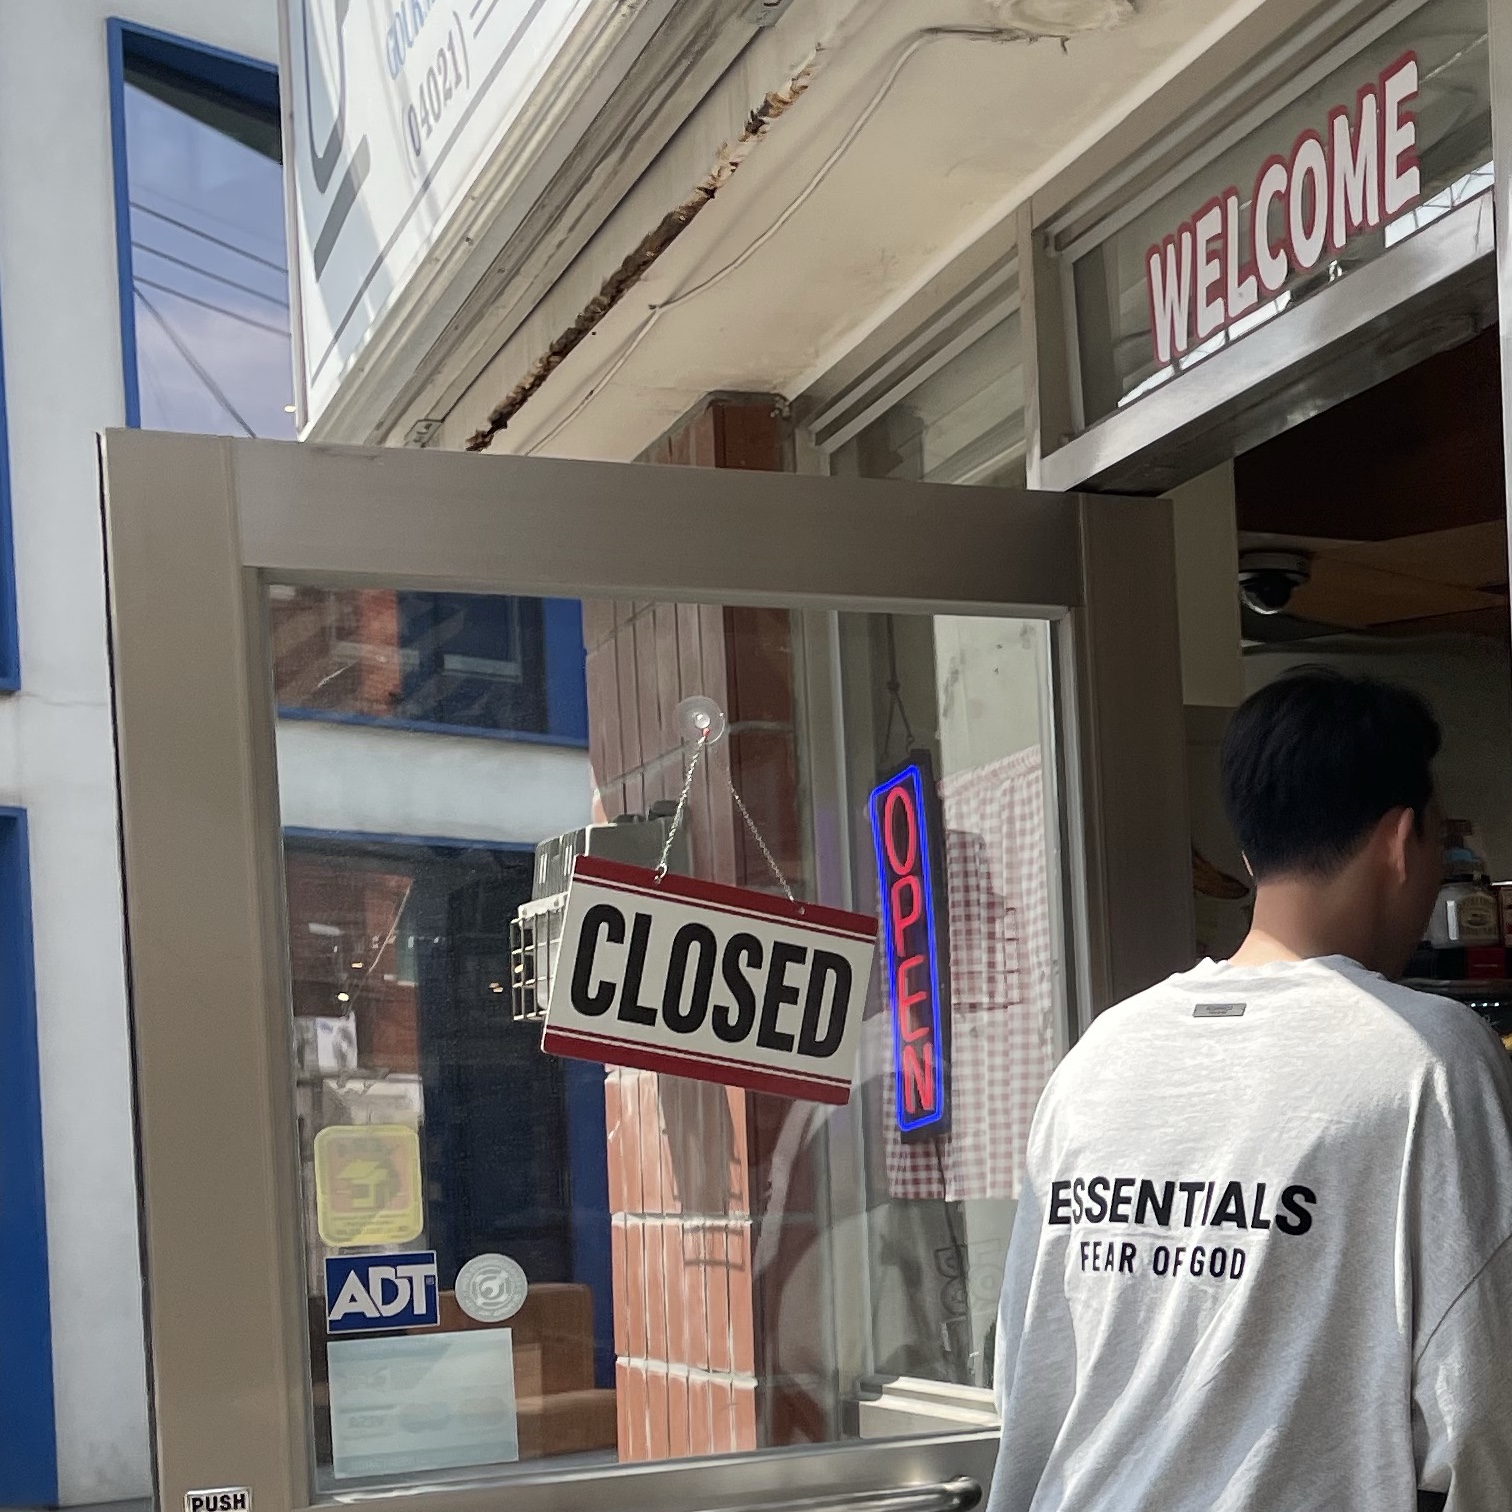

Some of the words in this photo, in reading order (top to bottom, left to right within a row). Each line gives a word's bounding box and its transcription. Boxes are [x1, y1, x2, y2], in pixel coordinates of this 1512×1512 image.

[1147, 50, 1421, 368] WELCOME
[570, 904, 853, 1060] CLOSED
[883, 786, 934, 1116] OPEN
[1049, 1176, 1317, 1236] ESSENTIALS
[329, 1263, 436, 1321] ADT
[1080, 1241, 1137, 1274] FEAR
[1189, 1246, 1247, 1280] GOD
